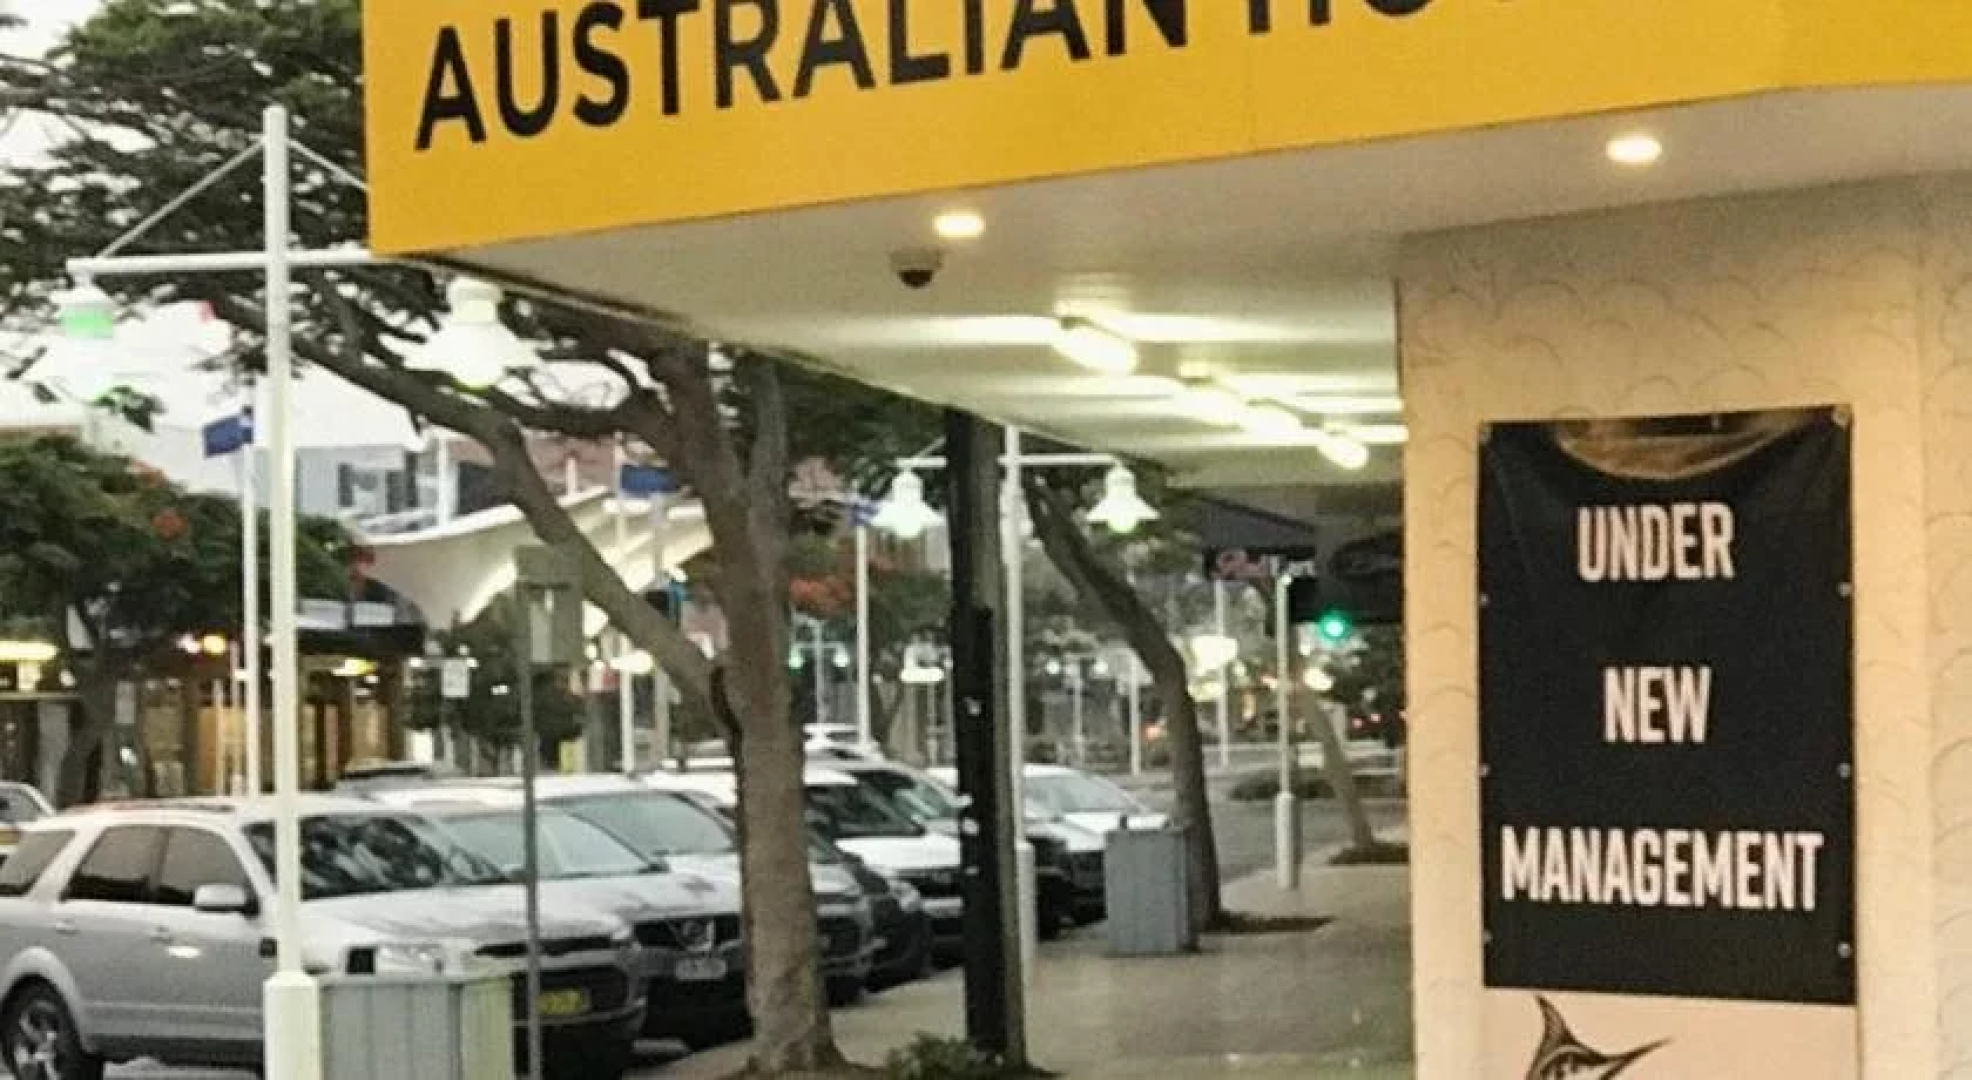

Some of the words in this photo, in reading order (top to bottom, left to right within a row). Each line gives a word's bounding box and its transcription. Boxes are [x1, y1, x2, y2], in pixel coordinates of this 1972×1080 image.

[1577, 502, 1735, 582] UNDER
[1603, 665, 1711, 744] NEW
[1501, 824, 1824, 911] MANAGEMENT
